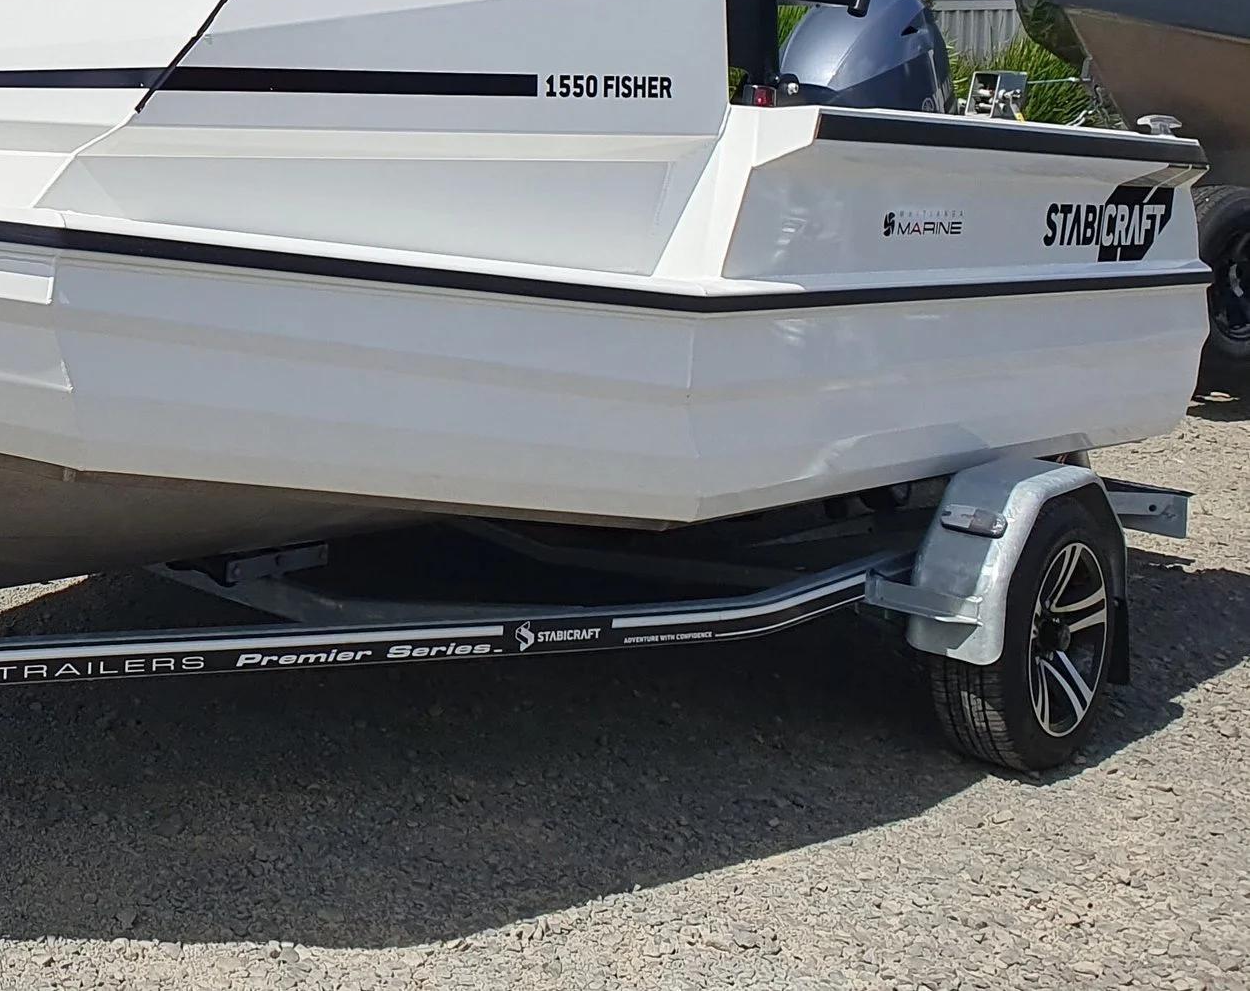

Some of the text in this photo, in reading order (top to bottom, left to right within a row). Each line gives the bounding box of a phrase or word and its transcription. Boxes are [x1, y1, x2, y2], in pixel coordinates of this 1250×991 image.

[546, 74, 672, 98] 1550 FISHER
[897, 221, 962, 235] MARINE
[1043, 203, 1166, 247] STABICRAFT
[537, 628, 601, 642] STABICRAFT
[623, 631, 713, 644] ADVENTURE WITH CONFIDENCE
[236, 649, 372, 667] Premier
